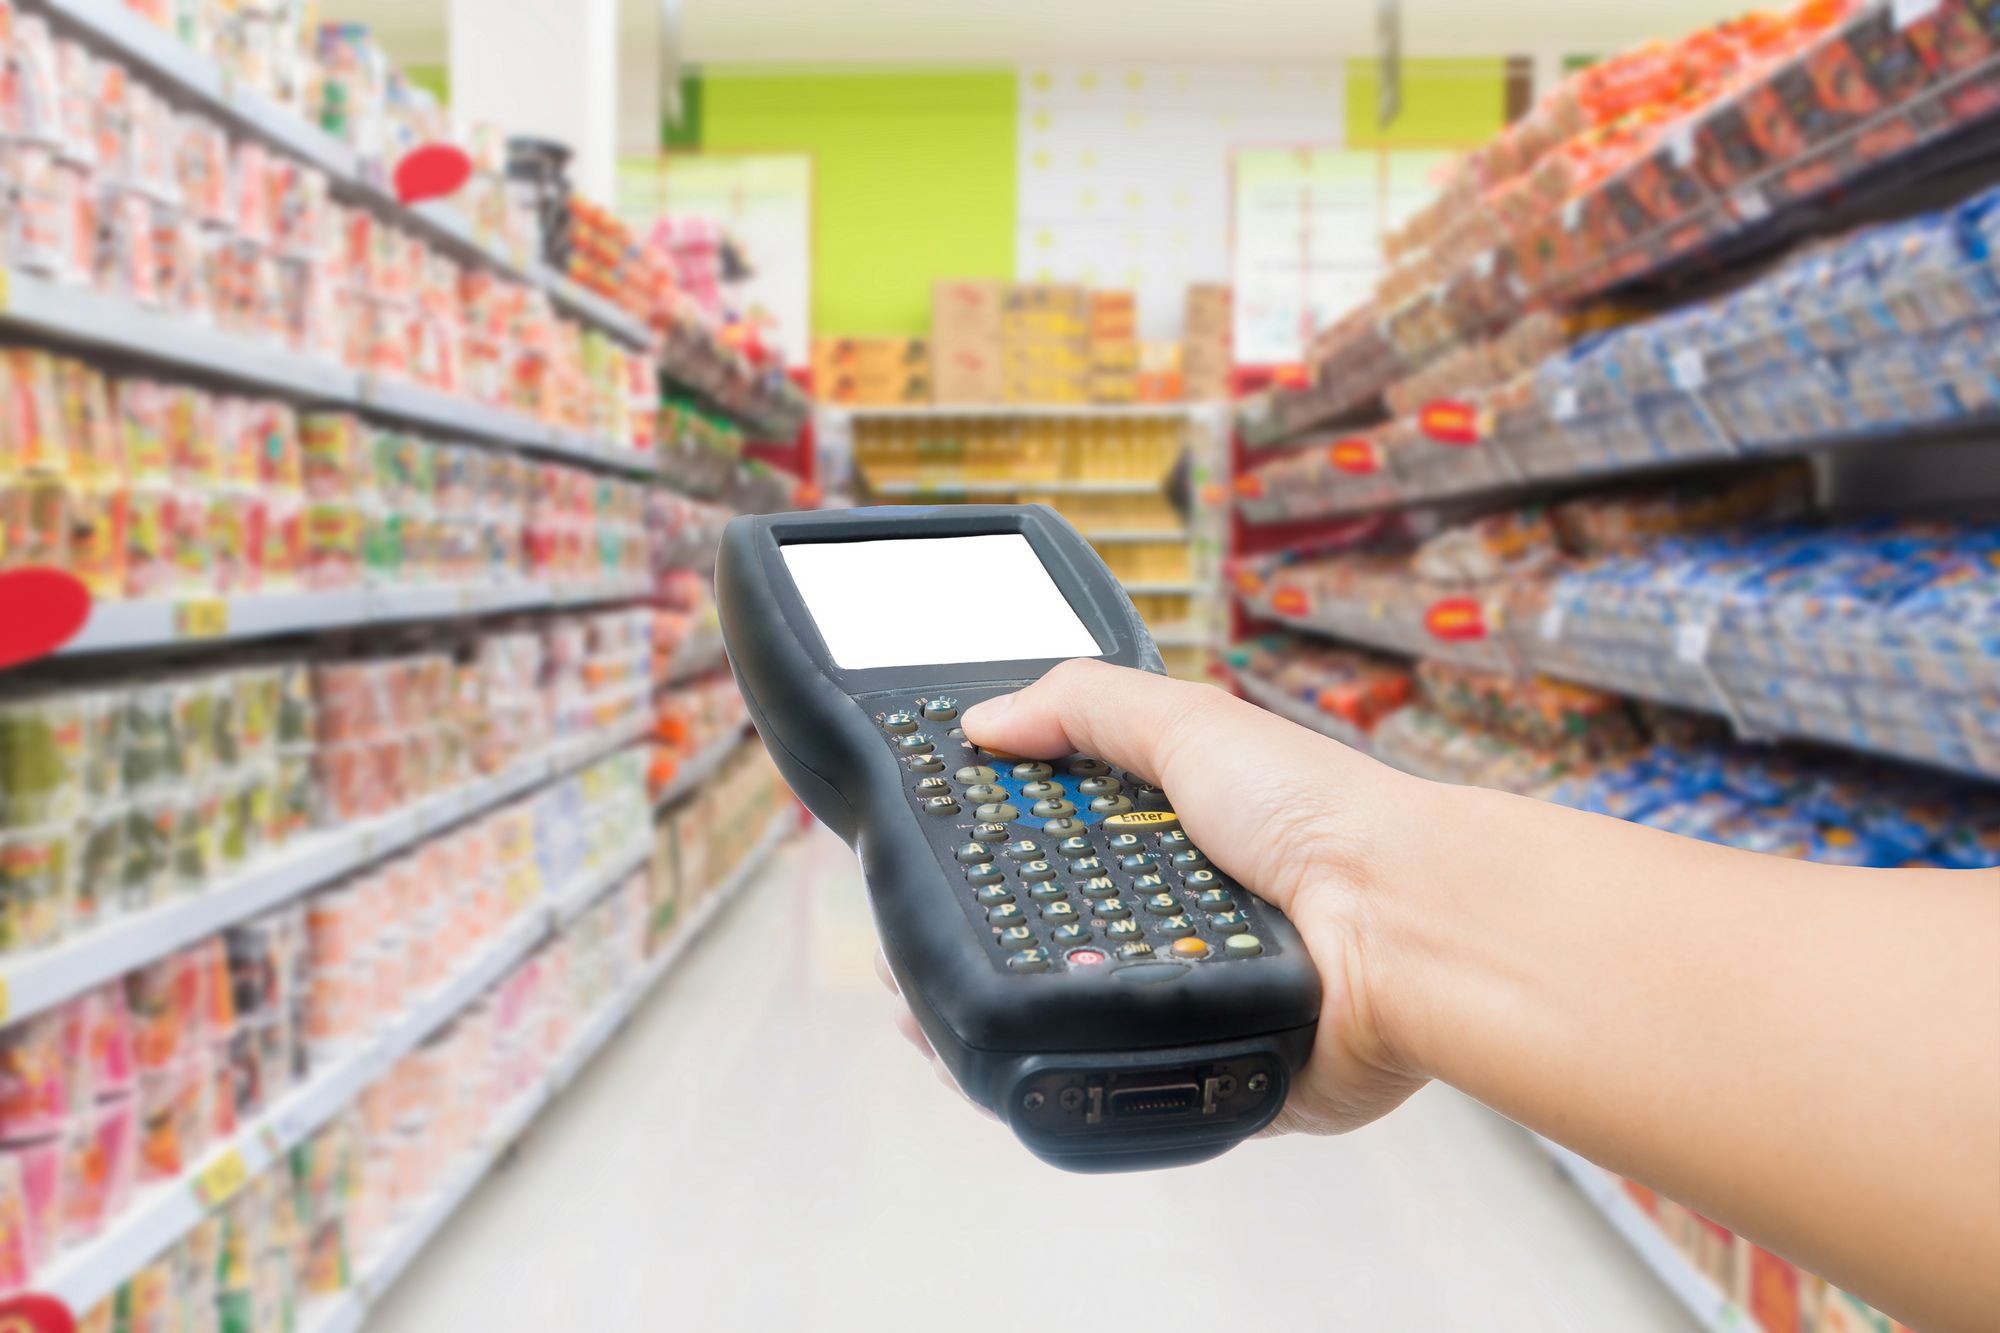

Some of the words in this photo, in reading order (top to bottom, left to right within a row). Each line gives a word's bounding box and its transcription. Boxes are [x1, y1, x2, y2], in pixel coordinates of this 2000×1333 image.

[931, 700, 950, 708] F3
[889, 714, 910, 722] F2
[906, 736, 925, 744] F1
[1028, 761, 1041, 772] 2
[922, 777, 943, 785] Alt
[1038, 780, 1051, 791] 5
[931, 796, 952, 805] Ctl
[1047, 798, 1062, 809] 8
[1103, 794, 1119, 806] 9
[1057, 817, 1072, 828] 0
[1121, 812, 1163, 823] Enter
[979, 822, 1003, 831] Tab
[1120, 834, 1137, 844] D
[1171, 831, 1185, 841] E
[1020, 840, 1035, 851] B
[1068, 837, 1085, 848] C
[968, 843, 984, 854] A
[1135, 854, 1144, 864] I
[1186, 850, 1196, 861] J
[1030, 860, 1048, 871] G
[1079, 857, 1099, 868] H
[979, 863, 992, 874] F
[1142, 874, 1162, 885] N
[1194, 870, 1213, 881] O
[1042, 881, 1057, 892] L
[1090, 877, 1113, 889] M
[988, 884, 1006, 896] K
[1184, 890, 1201, 899] %
[1207, 889, 1221, 901] T
[1105, 898, 1122, 910] R
[1157, 893, 1174, 906] S
[1000, 903, 1016, 916] P
[1051, 901, 1072, 913] Q
[1168, 916, 1188, 929] X
[1219, 912, 1236, 923] Y
[1062, 924, 1079, 936] V
[1112, 920, 1137, 933] W
[1009, 927, 1029, 939] U
[1023, 949, 1041, 962] Z
